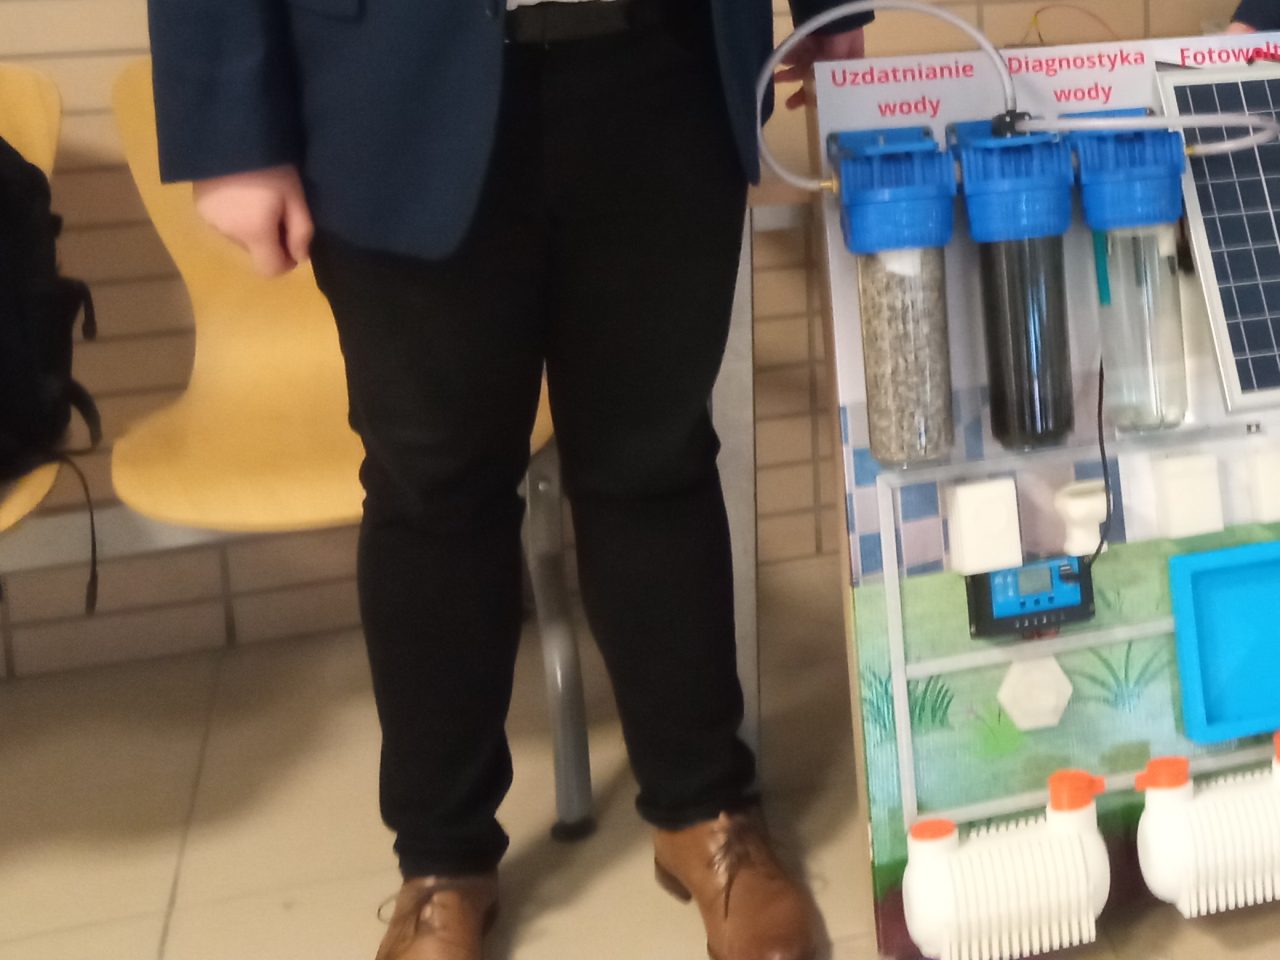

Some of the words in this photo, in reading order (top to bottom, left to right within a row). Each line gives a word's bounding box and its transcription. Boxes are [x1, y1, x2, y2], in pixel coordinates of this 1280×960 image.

[831, 59, 975, 87] Uzdatnianie
[1007, 49, 1146, 78] Diagnostyka
[1053, 81, 1113, 105] wody
[878, 95, 941, 118] wody
